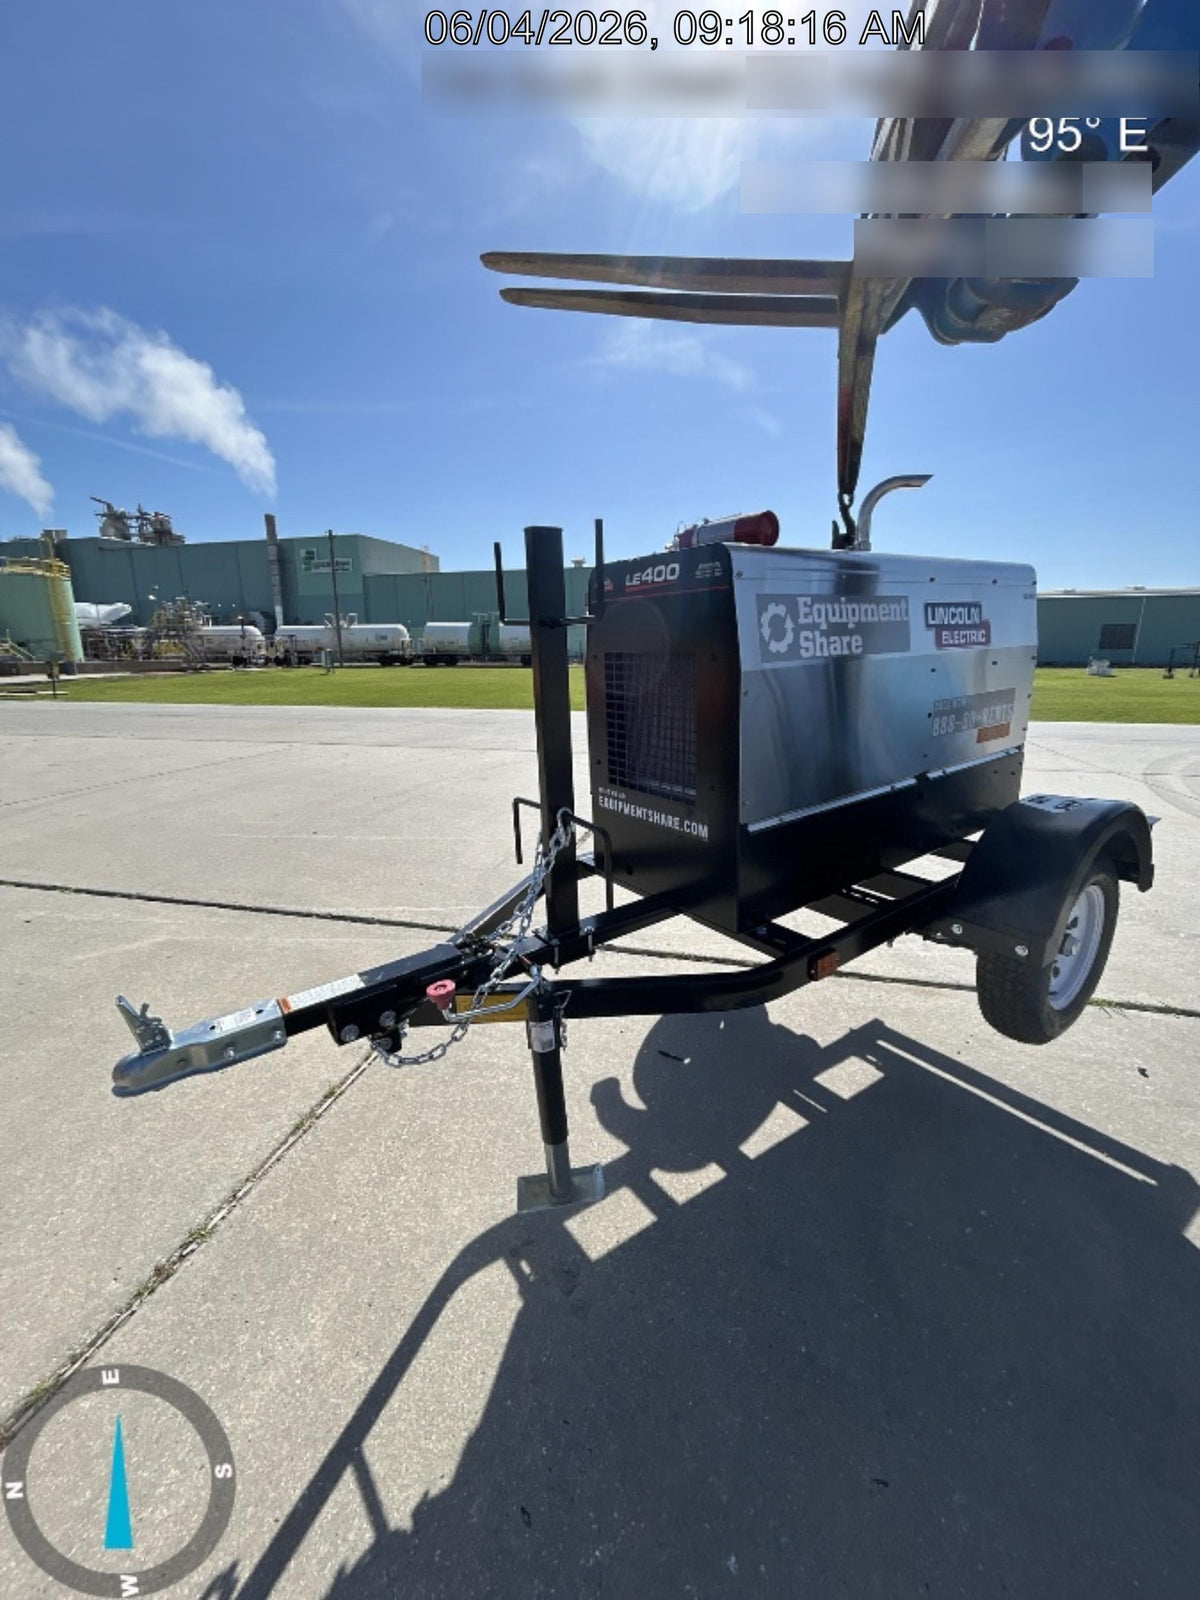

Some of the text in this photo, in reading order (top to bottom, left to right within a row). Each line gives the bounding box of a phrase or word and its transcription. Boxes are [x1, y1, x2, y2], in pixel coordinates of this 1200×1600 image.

[625, 563, 680, 586] LE400
[797, 596, 909, 630] Equipment
[927, 605, 981, 625] LINCOLN
[800, 630, 864, 659] Share
[941, 629, 986, 644] ELECTRIC
